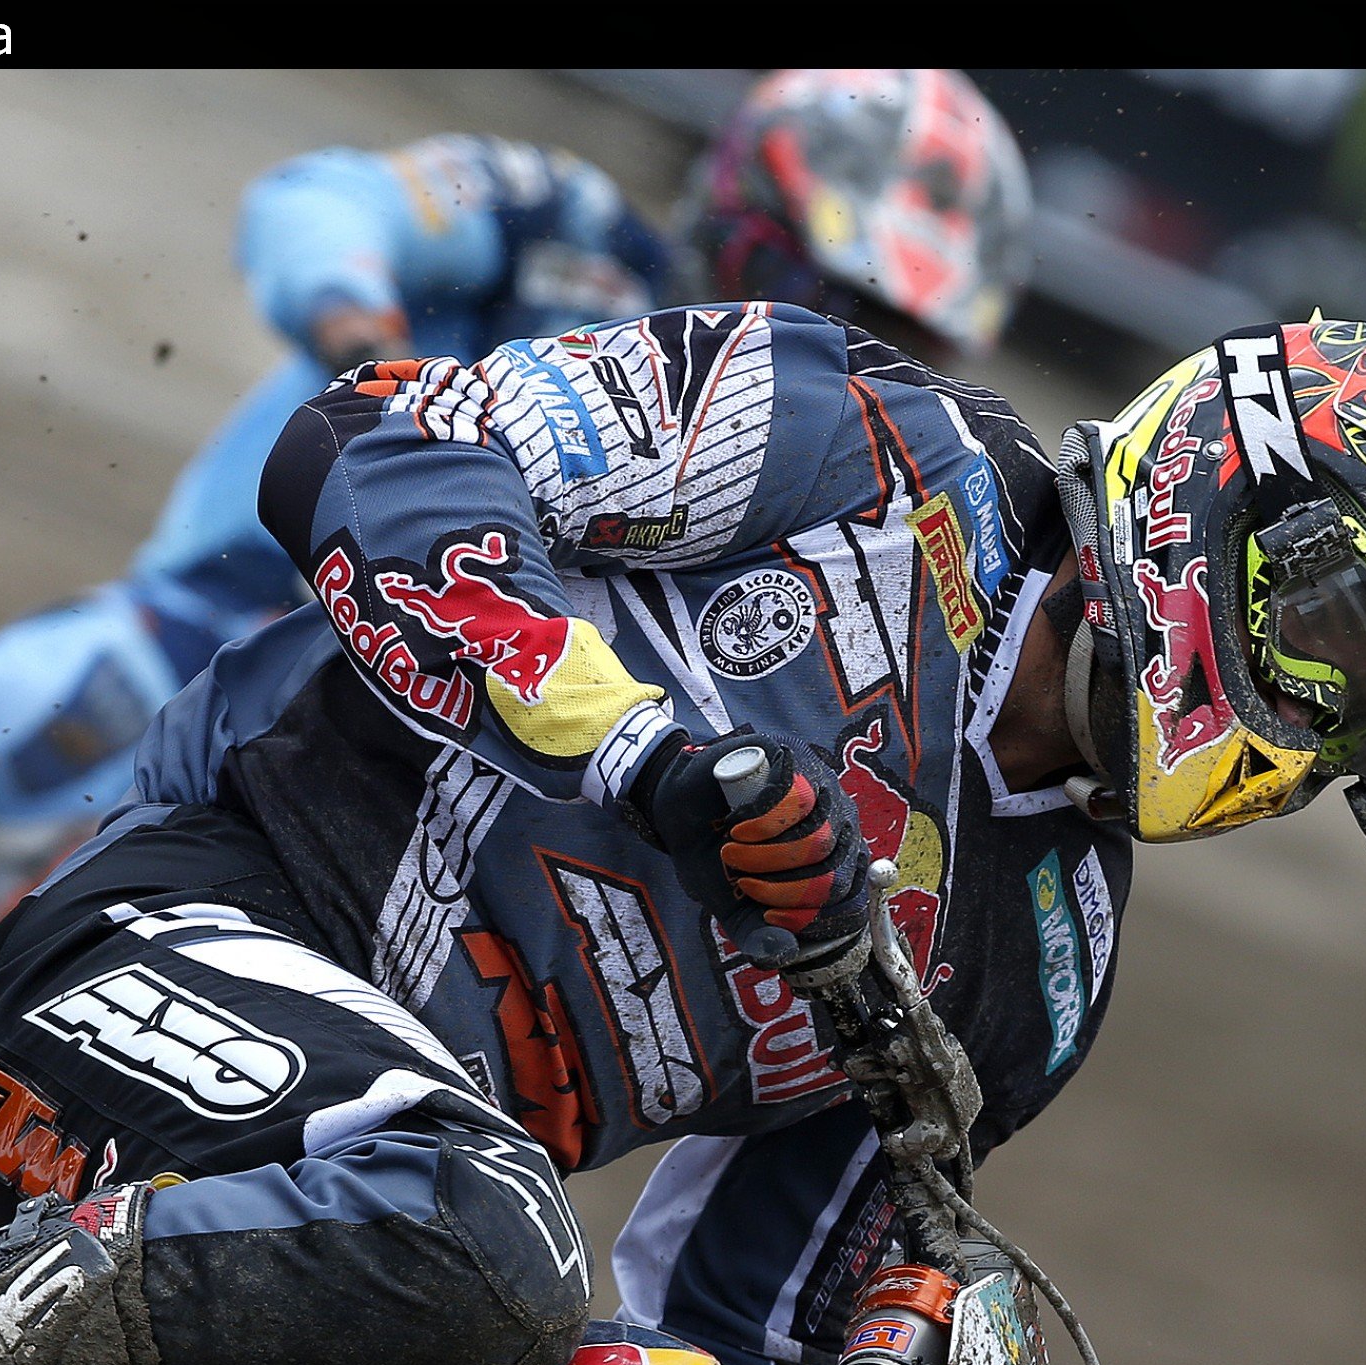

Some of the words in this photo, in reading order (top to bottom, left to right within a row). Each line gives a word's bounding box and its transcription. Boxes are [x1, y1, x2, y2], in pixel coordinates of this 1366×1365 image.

[522, 366, 592, 456] MAPEI
[916, 505, 979, 640] PIRELLI
[976, 500, 1003, 575] MAPEI
[718, 590, 737, 609] OUT
[745, 573, 812, 616] SCORPION
[788, 624, 810, 652] BAY
[713, 656, 741, 674] MAS
[748, 653, 780, 674] FINA
[1074, 855, 1114, 981] DIMOCO
[1039, 903, 1081, 1066] MOTOREX
